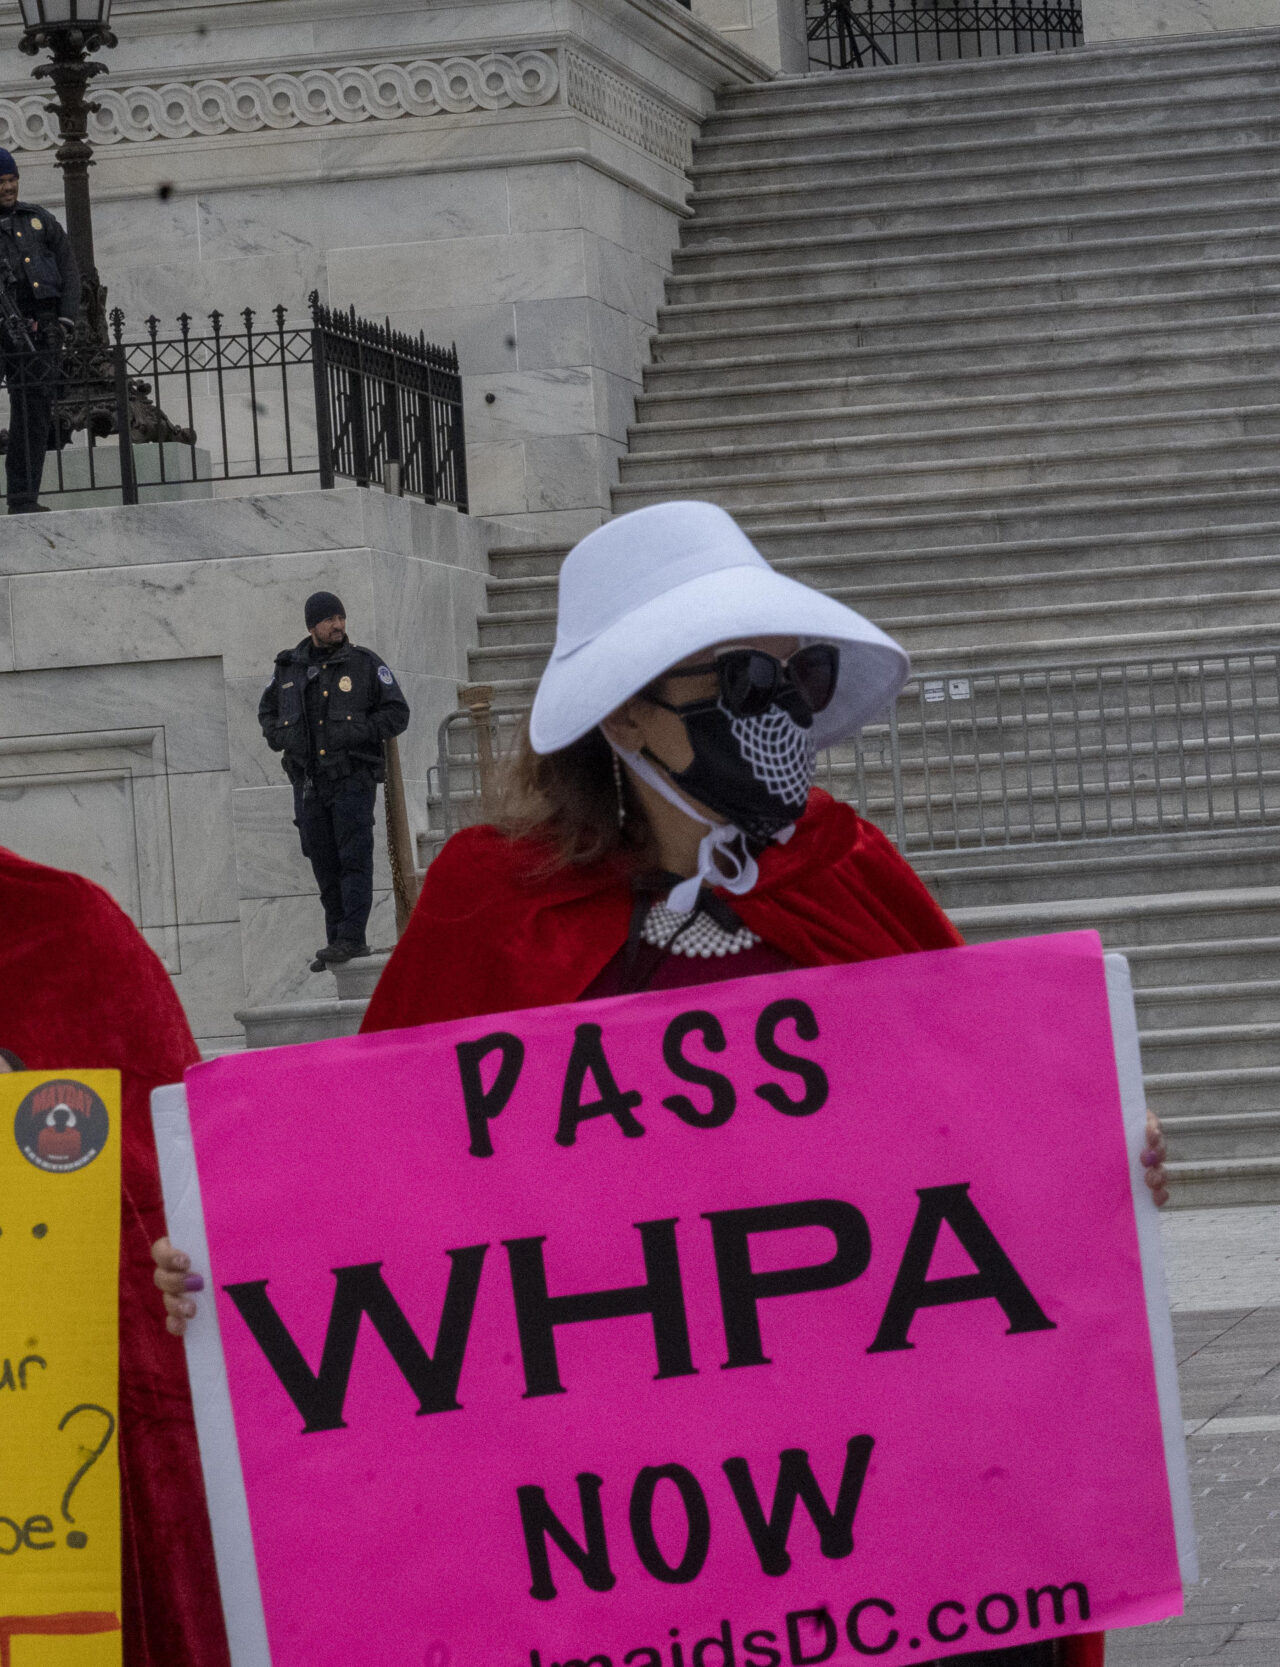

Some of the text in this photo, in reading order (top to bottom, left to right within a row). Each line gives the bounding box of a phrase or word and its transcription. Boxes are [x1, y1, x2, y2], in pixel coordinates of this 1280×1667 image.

[455, 998, 829, 1158] PASS
[222, 1182, 1058, 1436] WHPA
[516, 1434, 876, 1602] NOW
[529, 1581, 1092, 1667] idsDC.com
